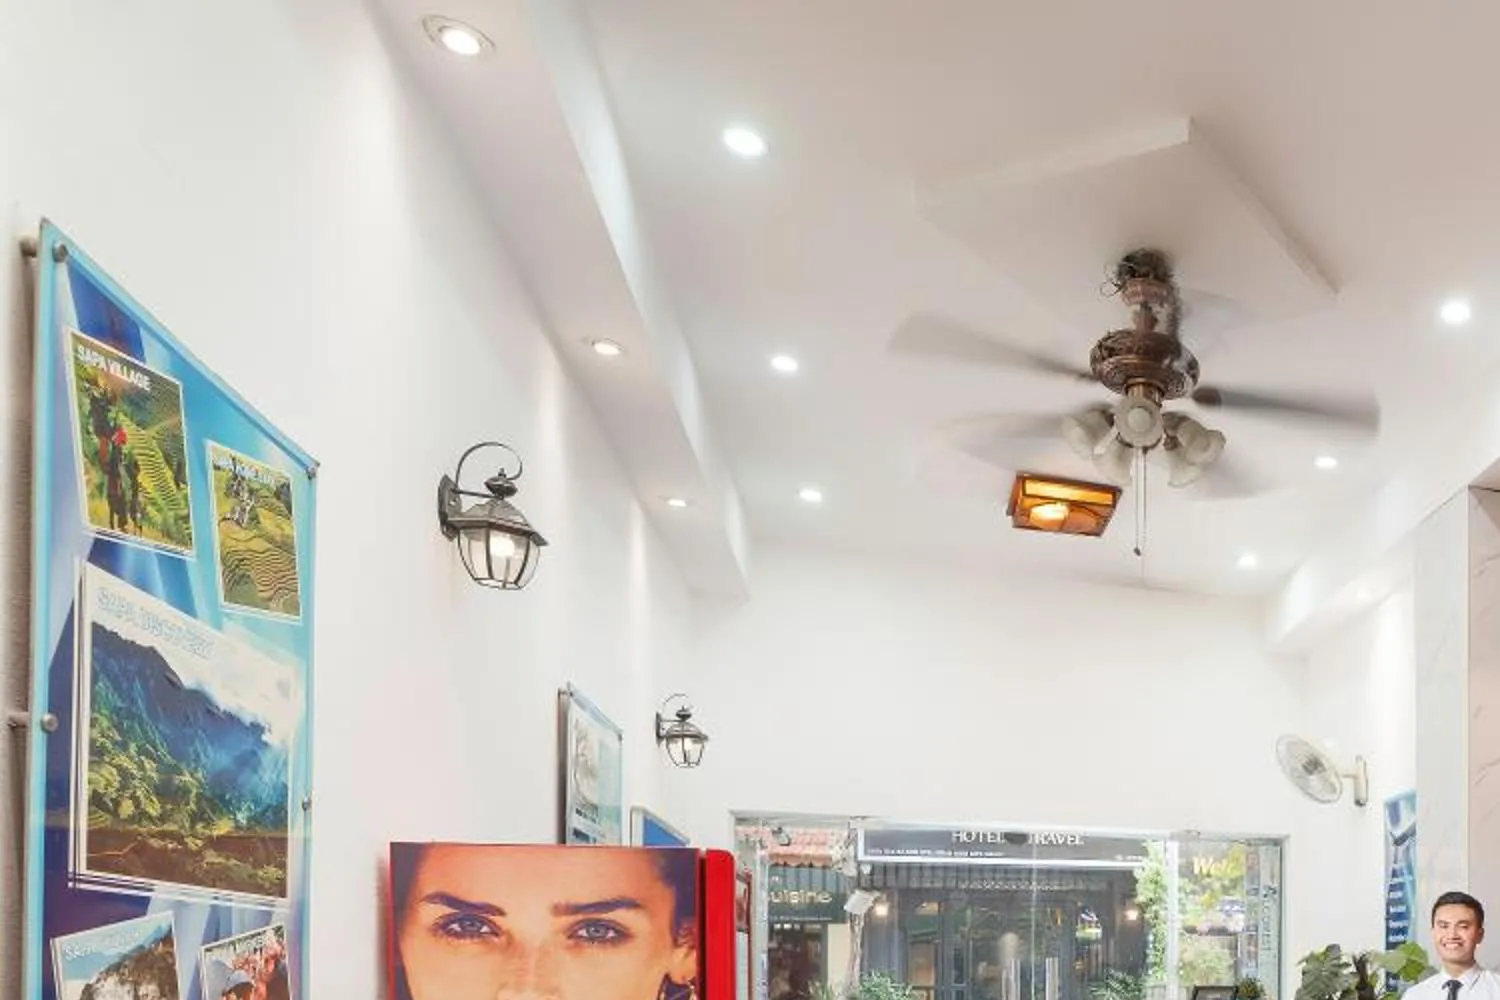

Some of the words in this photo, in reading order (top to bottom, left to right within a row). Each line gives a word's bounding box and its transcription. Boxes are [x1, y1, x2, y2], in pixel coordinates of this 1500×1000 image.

[77, 345, 108, 372] SAPA
[108, 359, 151, 391] VILLAGE
[952, 831, 1006, 843] HOTEL
[769, 890, 833, 904] uisine
